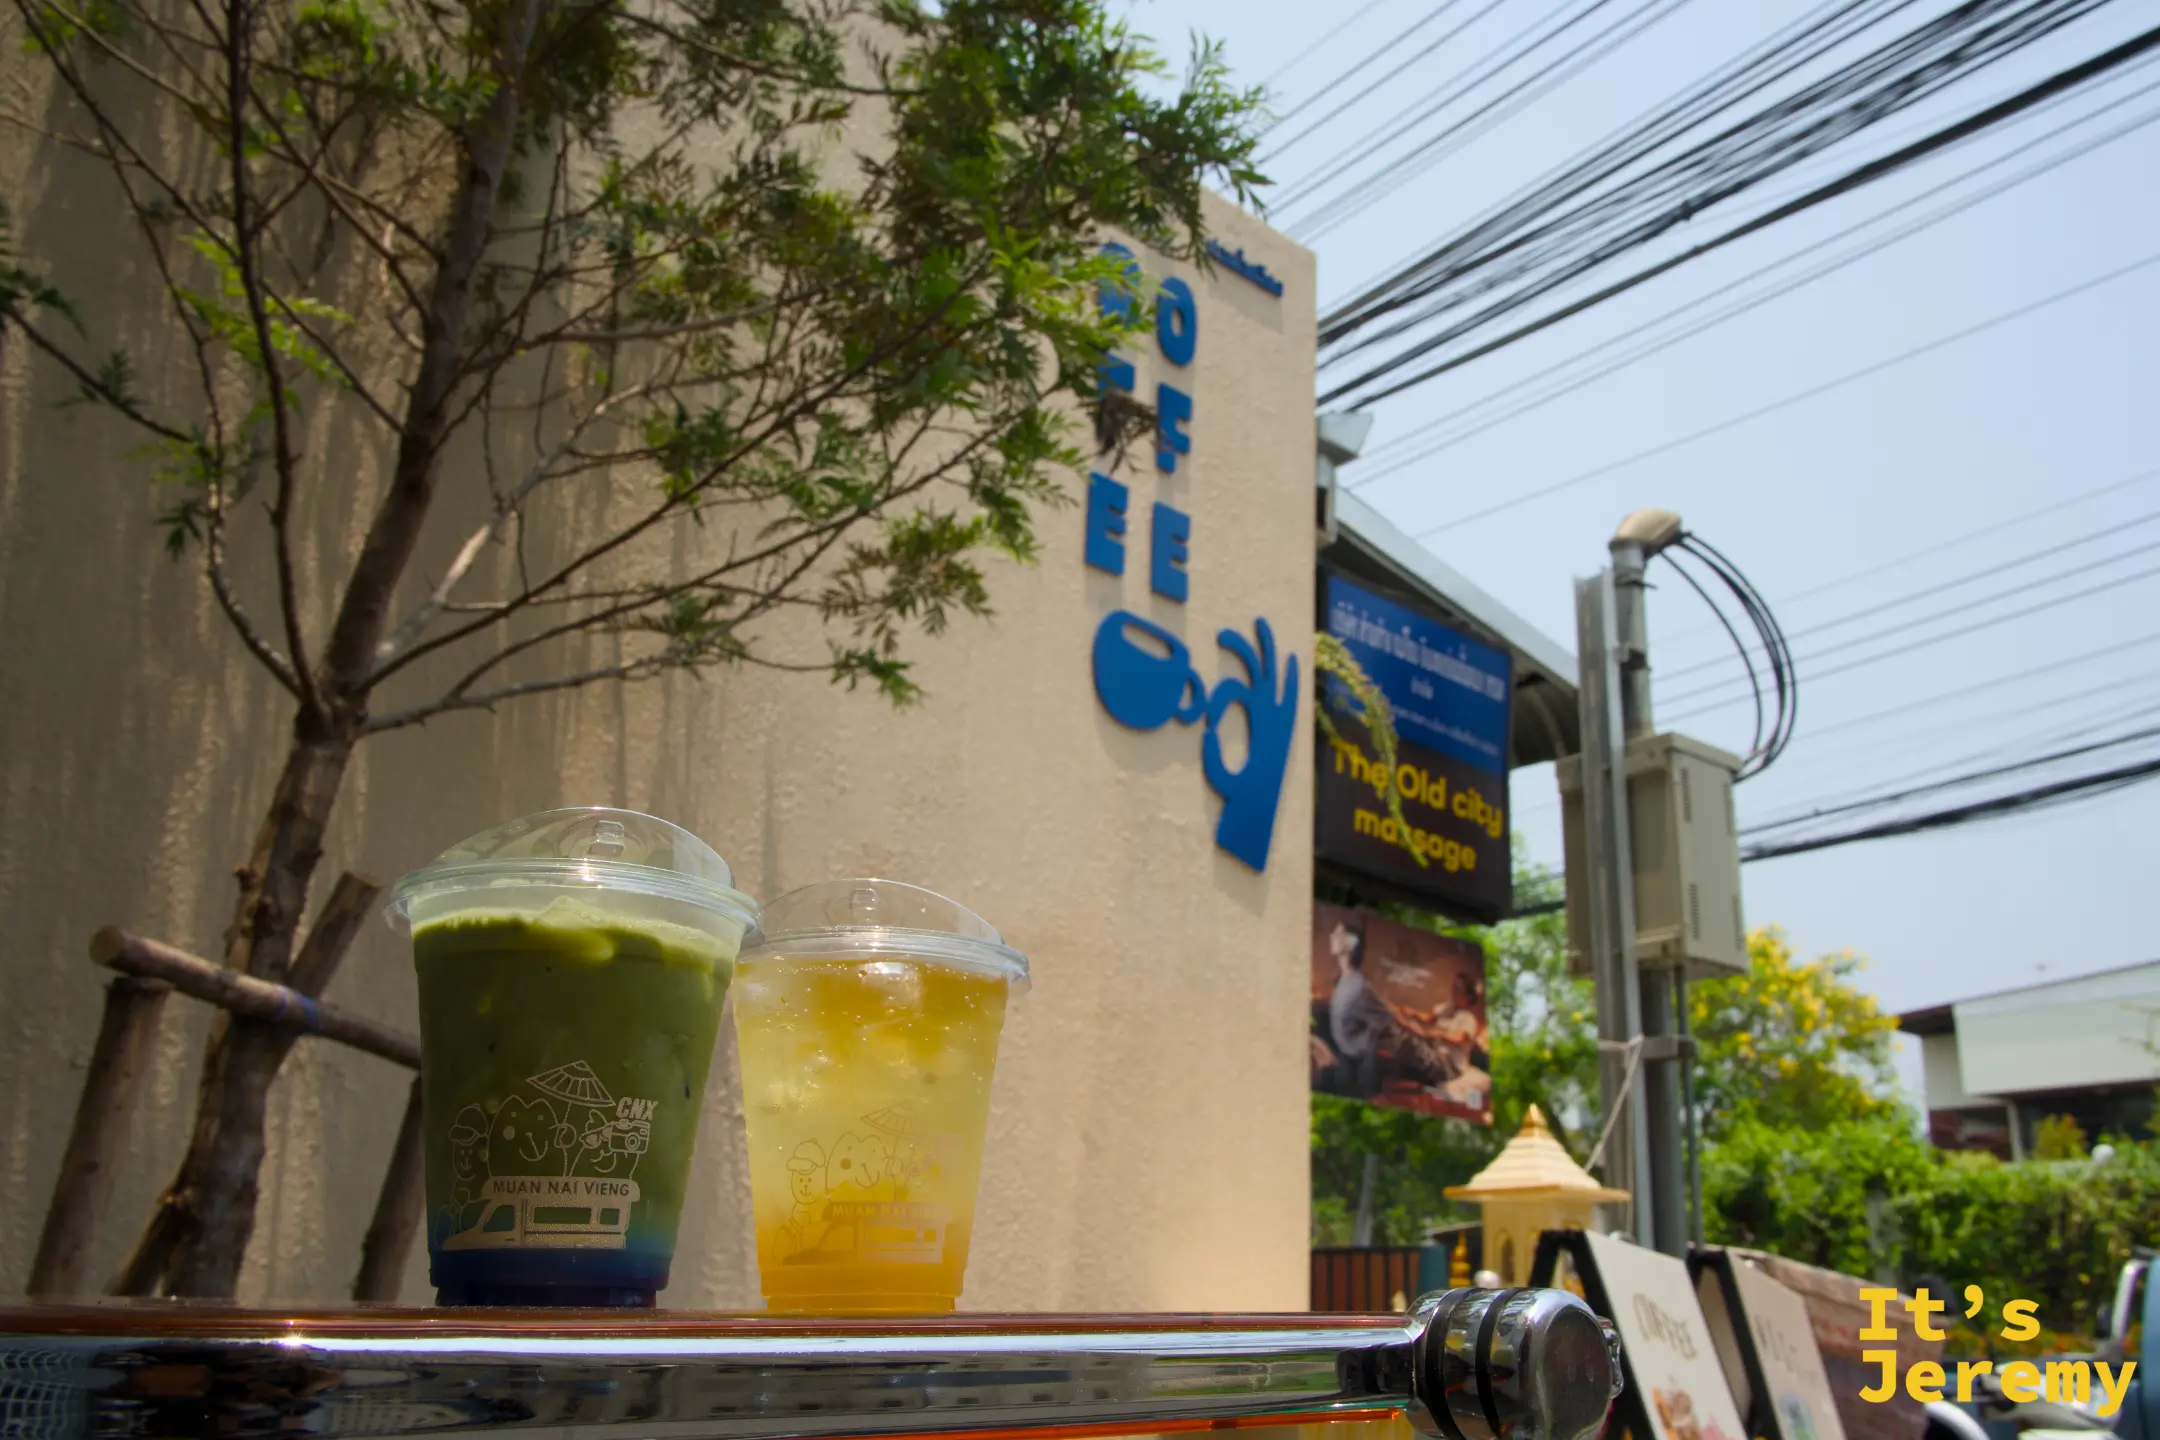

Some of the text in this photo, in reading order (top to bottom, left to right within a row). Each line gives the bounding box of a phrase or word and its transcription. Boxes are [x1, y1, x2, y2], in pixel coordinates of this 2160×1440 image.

[1332, 739, 1503, 840] The Old city
[616, 1096, 659, 1121] CNX
[493, 1179, 630, 1198] MUAN NAI VIENG
[832, 1203, 875, 1219] MUAN
